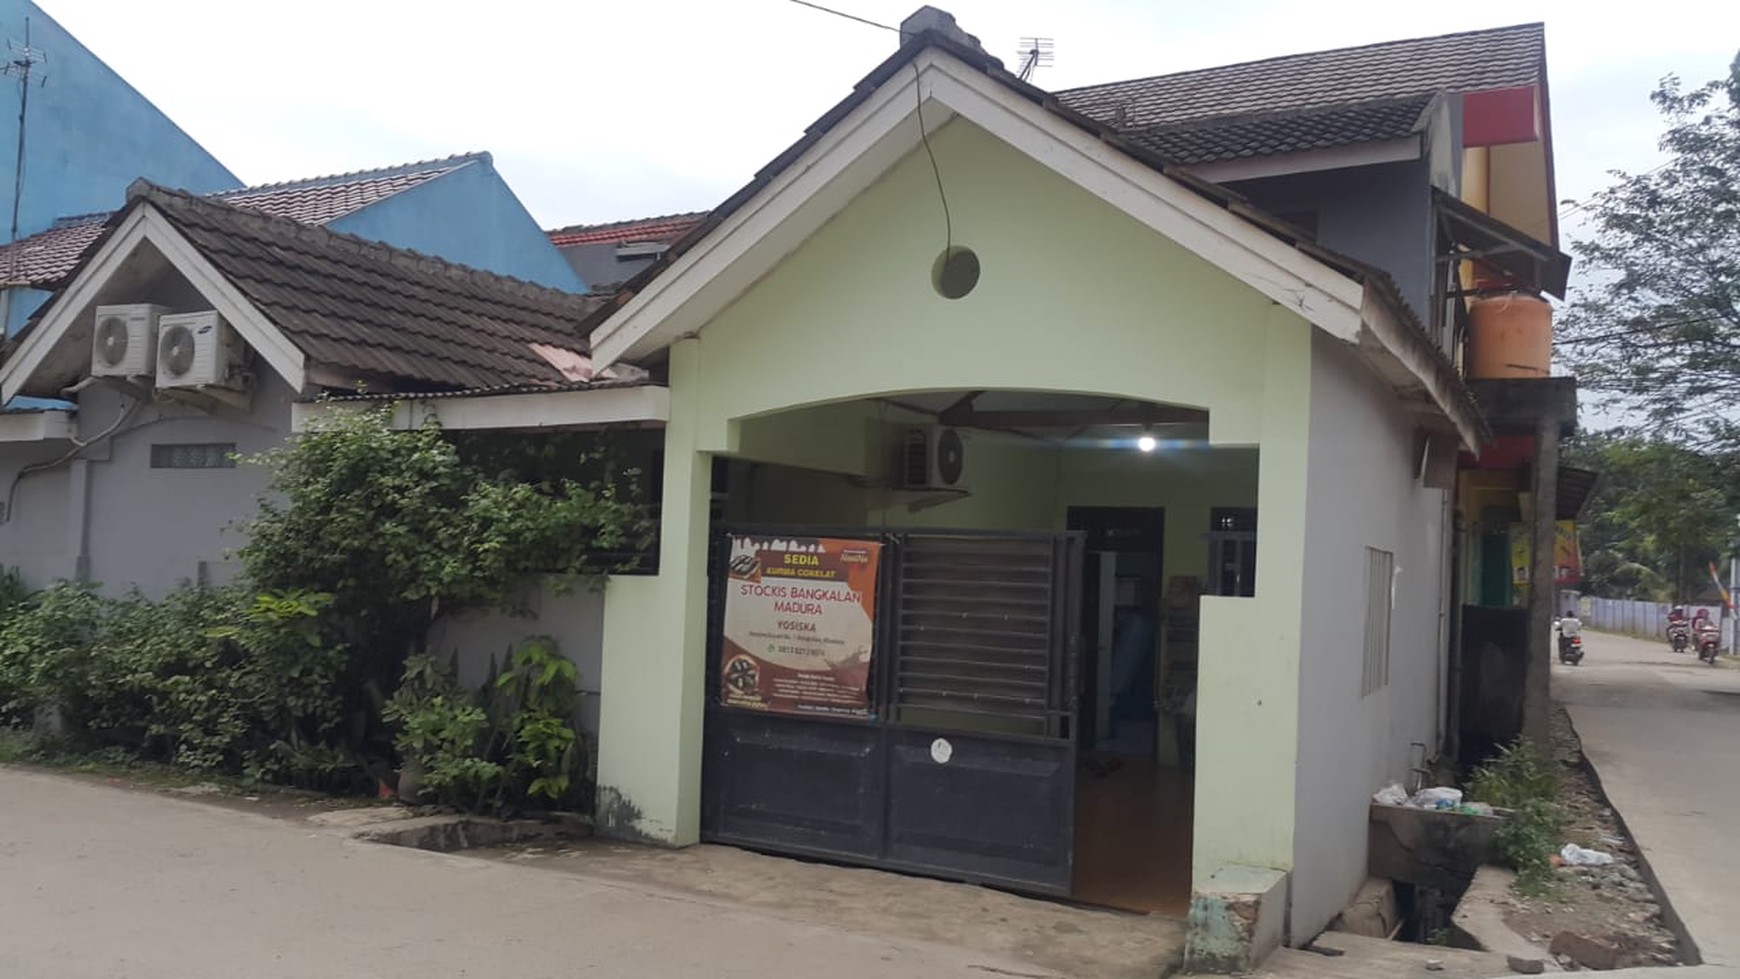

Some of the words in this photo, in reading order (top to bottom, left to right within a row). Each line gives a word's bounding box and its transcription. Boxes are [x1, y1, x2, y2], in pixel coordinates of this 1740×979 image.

[784, 554, 819, 566] SEDIA
[740, 584, 788, 597] STOCKIS
[790, 587, 861, 603] BANGKALAN
[773, 602, 823, 615] MADURA
[777, 620, 817, 632] YOSISKA
